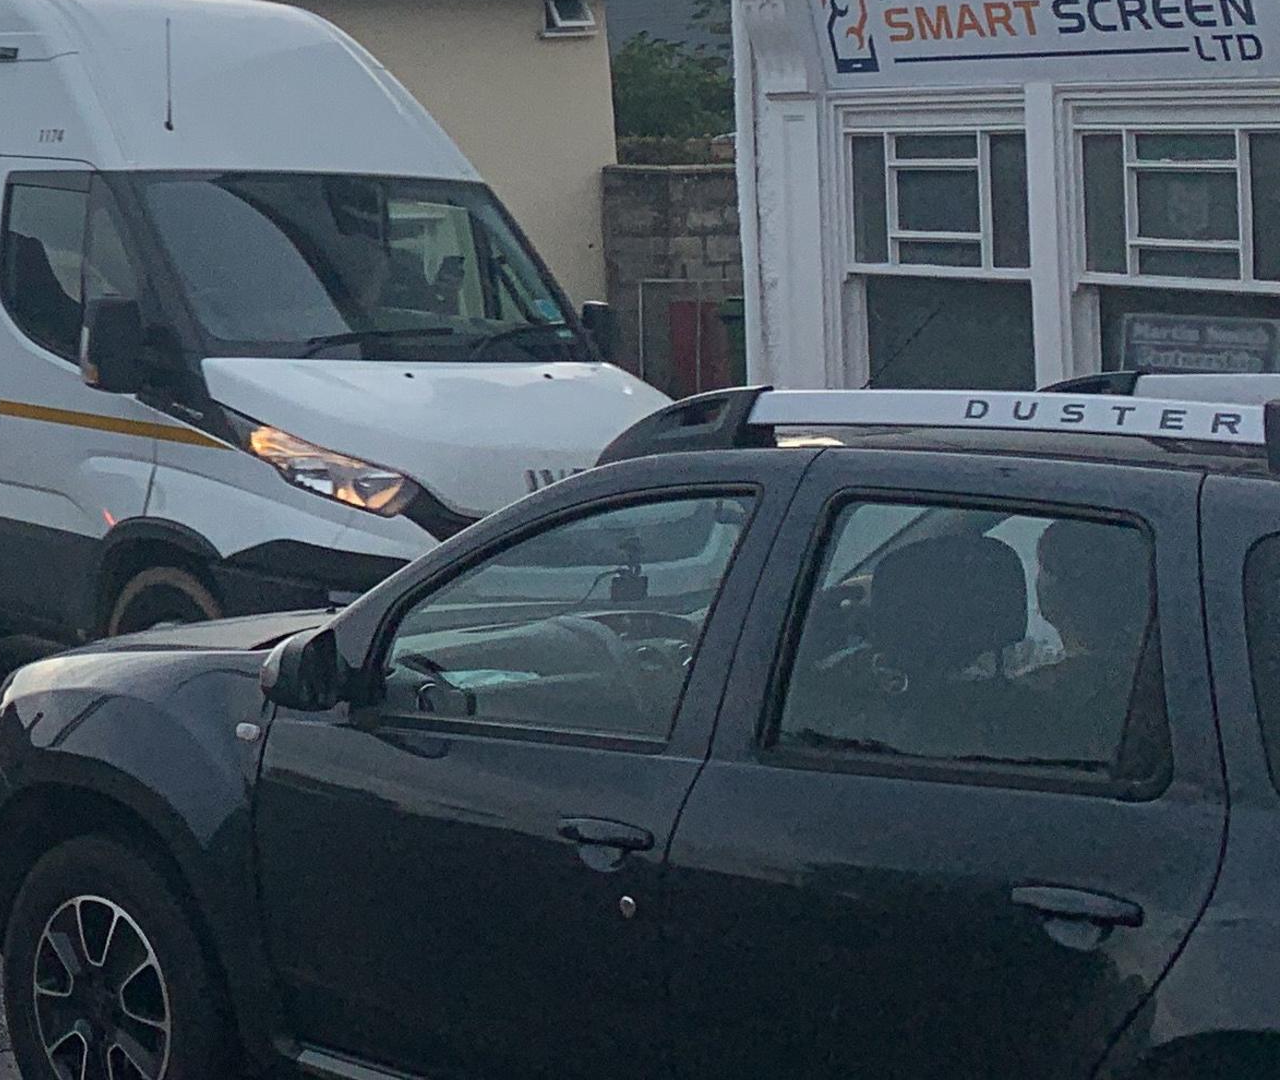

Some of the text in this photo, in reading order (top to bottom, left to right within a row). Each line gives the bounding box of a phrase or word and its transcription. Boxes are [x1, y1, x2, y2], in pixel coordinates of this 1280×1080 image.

[884, 0, 1040, 43] SMART
[1194, 34, 1264, 62] LTD
[964, 399, 1243, 435] DUSTER
